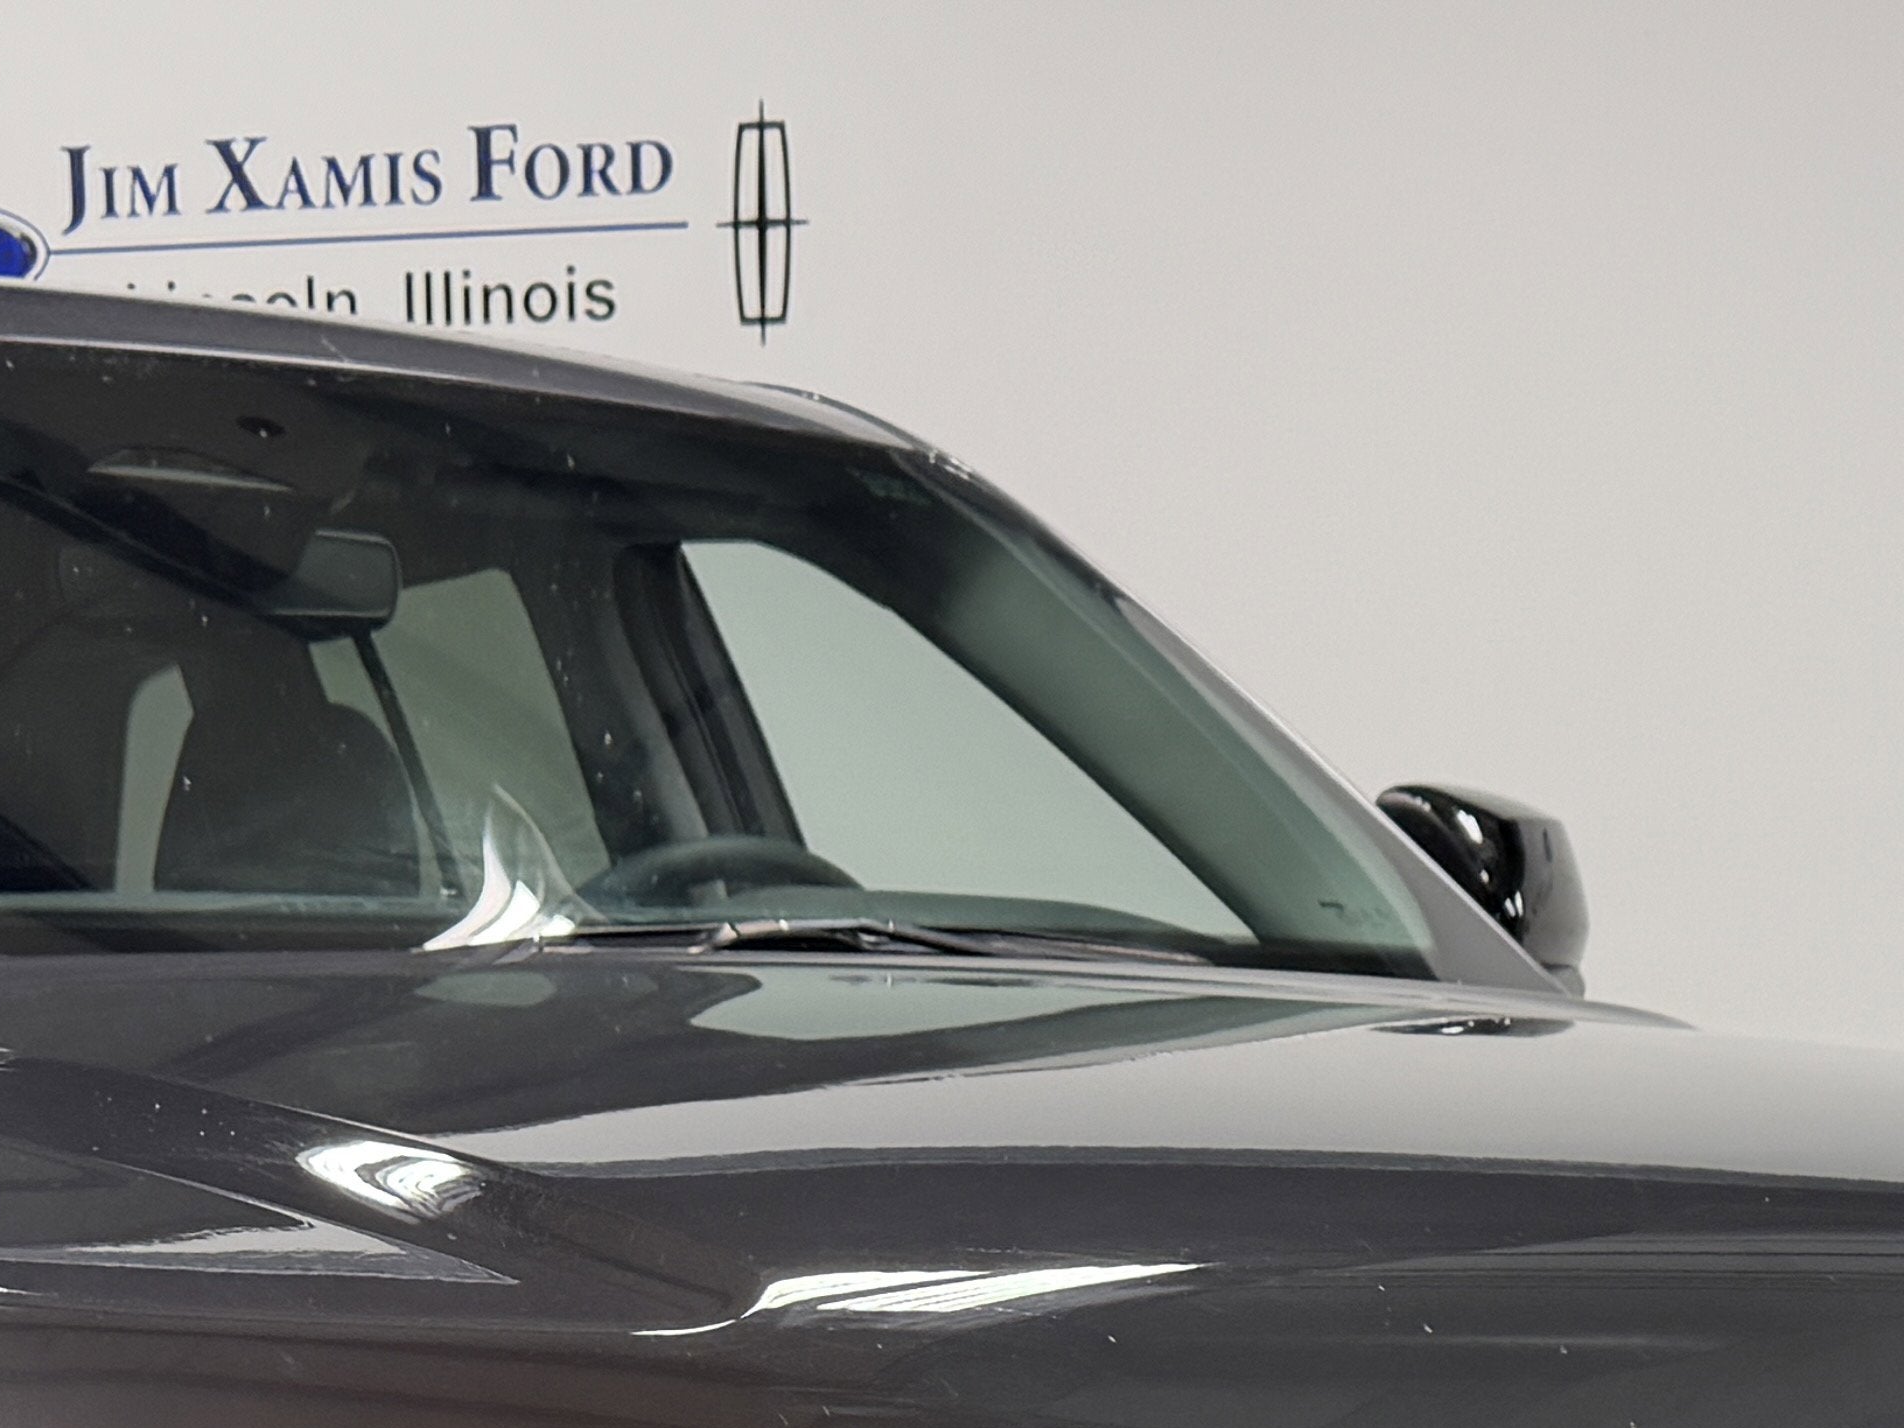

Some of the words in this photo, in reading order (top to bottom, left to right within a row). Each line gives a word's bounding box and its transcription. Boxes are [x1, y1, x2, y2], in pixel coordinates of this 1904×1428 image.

[59, 144, 183, 236] JIM
[205, 135, 443, 214] XAMIS
[467, 123, 674, 202] FORD
[405, 266, 617, 325] Illinois
